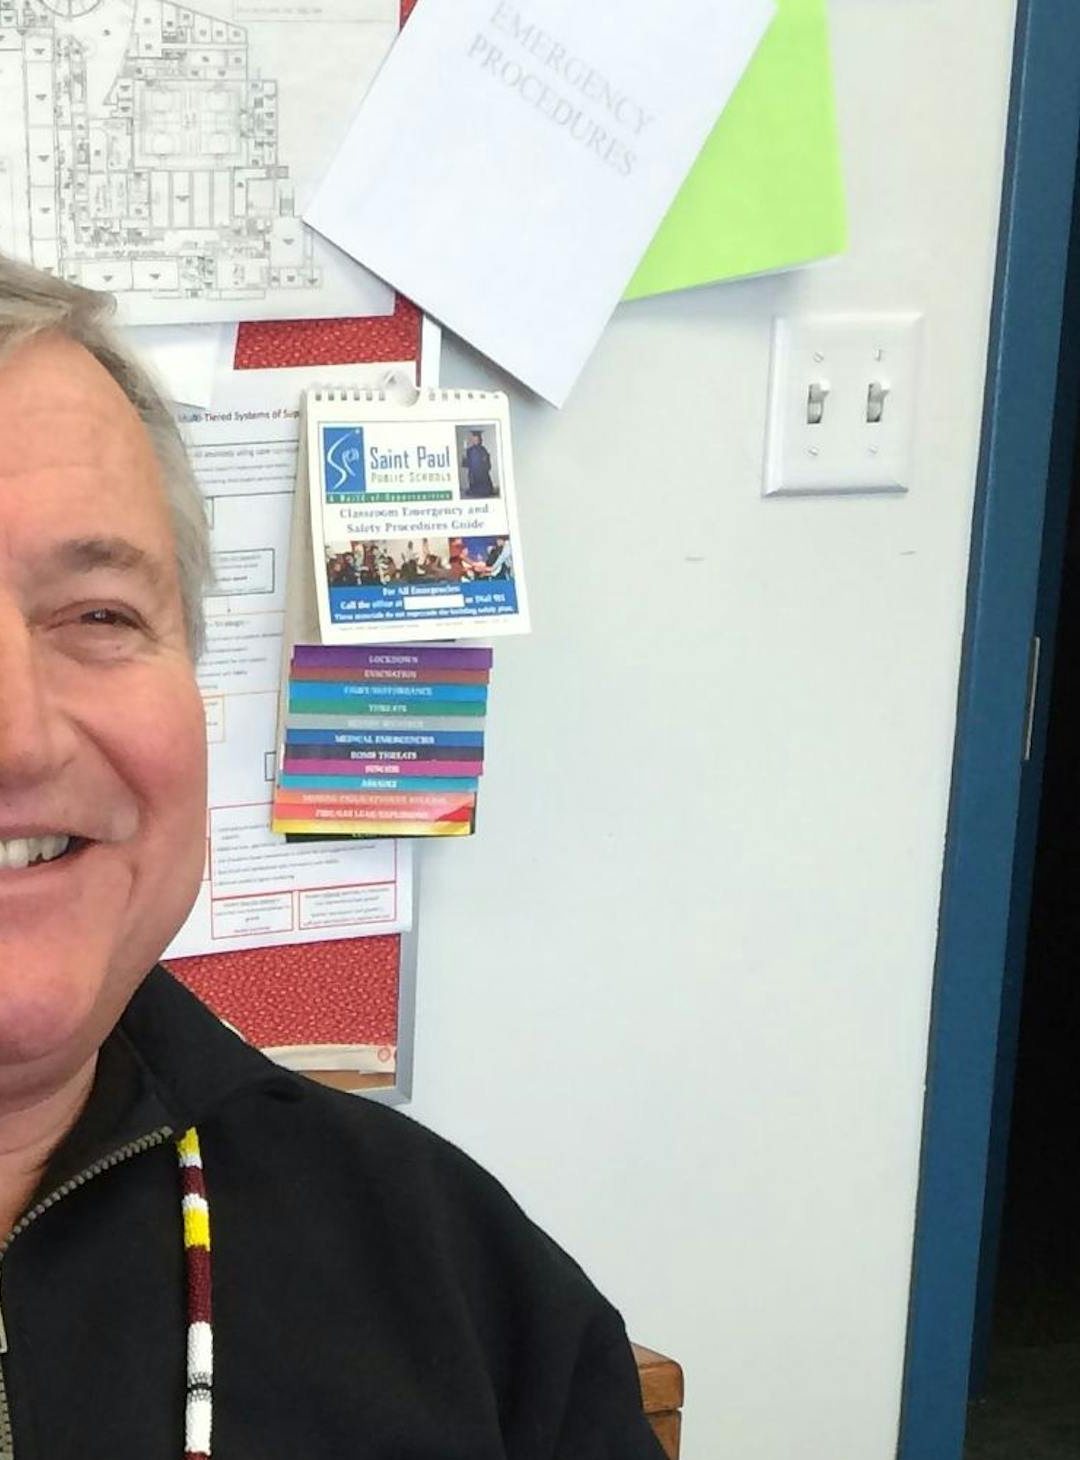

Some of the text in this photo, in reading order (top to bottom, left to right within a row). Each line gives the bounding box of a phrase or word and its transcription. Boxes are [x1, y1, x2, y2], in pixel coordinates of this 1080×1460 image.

[490, 0, 656, 136] EMERGENCY
[467, 32, 637, 177] PROCEDURES
[370, 446, 451, 470] Saint Paul
[339, 503, 489, 520] Classroom Emergency and
[346, 518, 485, 534] Safety Procedures Guide
[339, 600, 356, 611] Call
[369, 655, 419, 664] LOCKDOWN
[378, 751, 417, 760] THREATS
